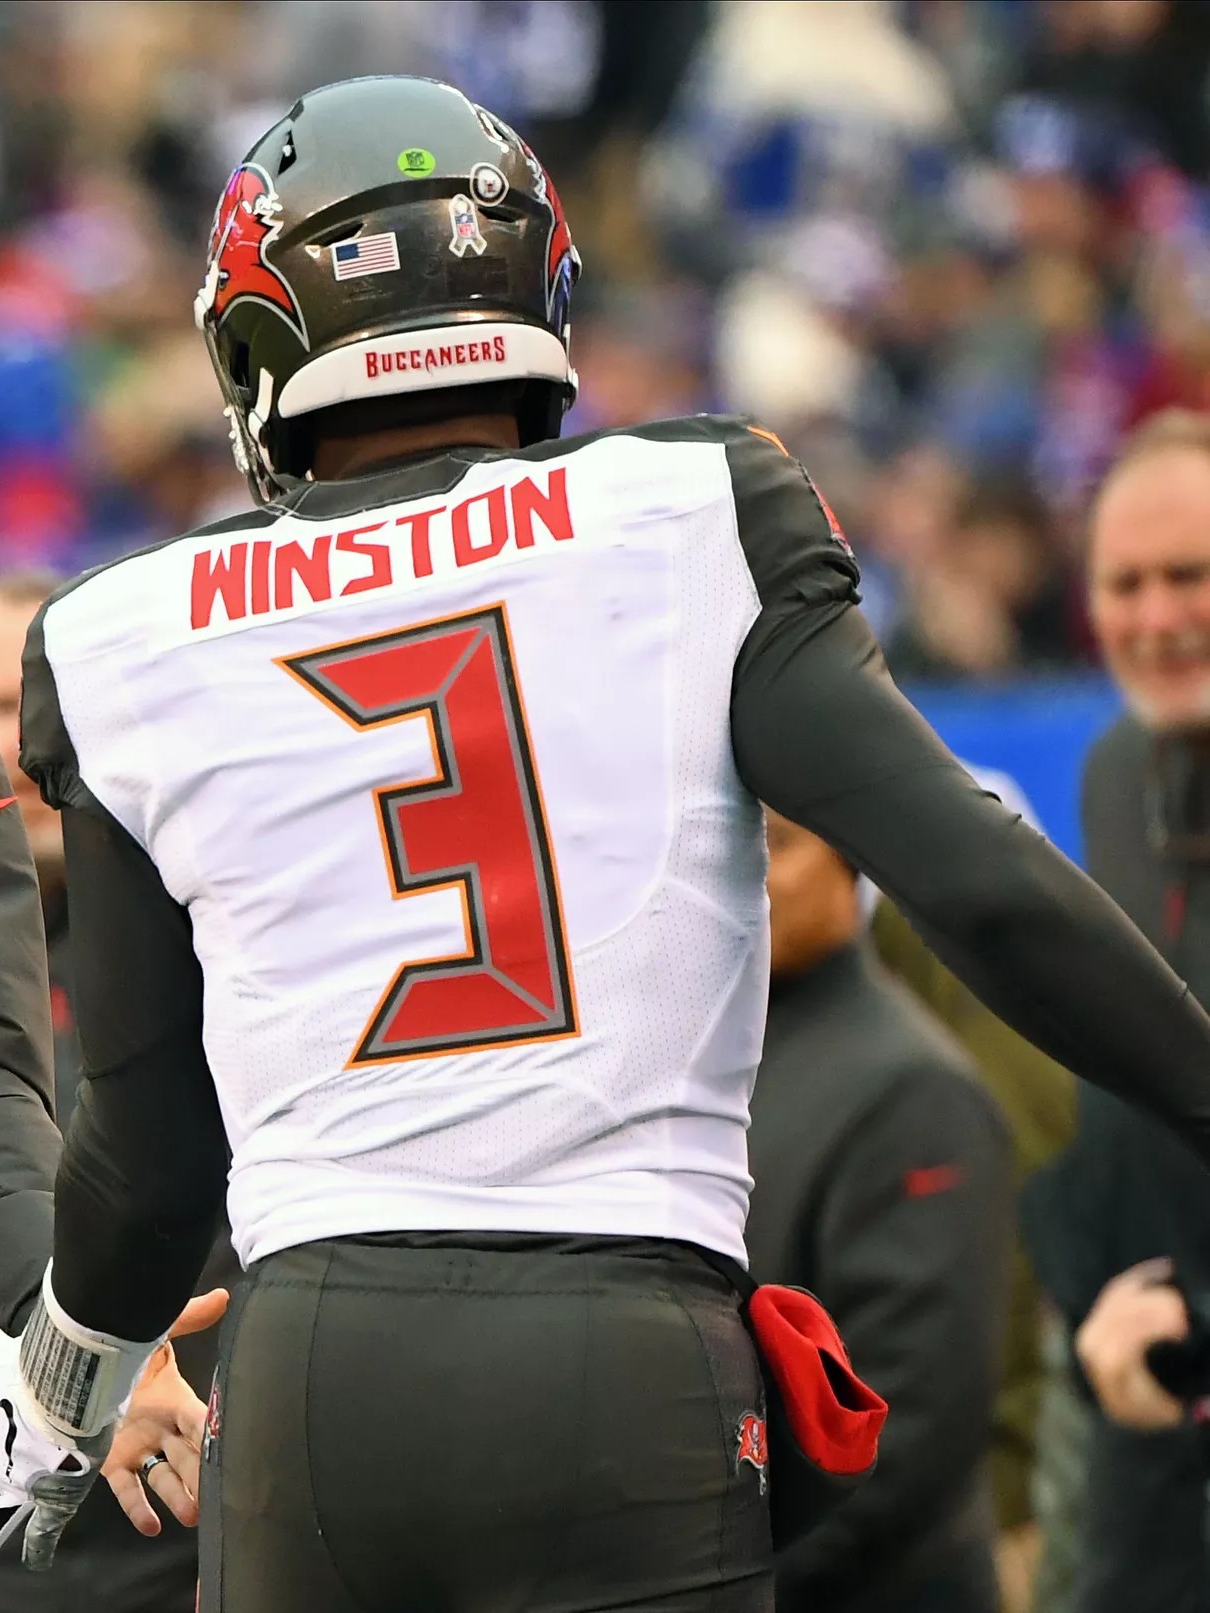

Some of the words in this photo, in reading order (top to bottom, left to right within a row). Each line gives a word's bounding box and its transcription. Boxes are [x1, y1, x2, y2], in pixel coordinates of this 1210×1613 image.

[366, 336, 506, 378] BUCCANEERS
[190, 467, 574, 630] WINSTON
[271, 600, 582, 1070] 3
